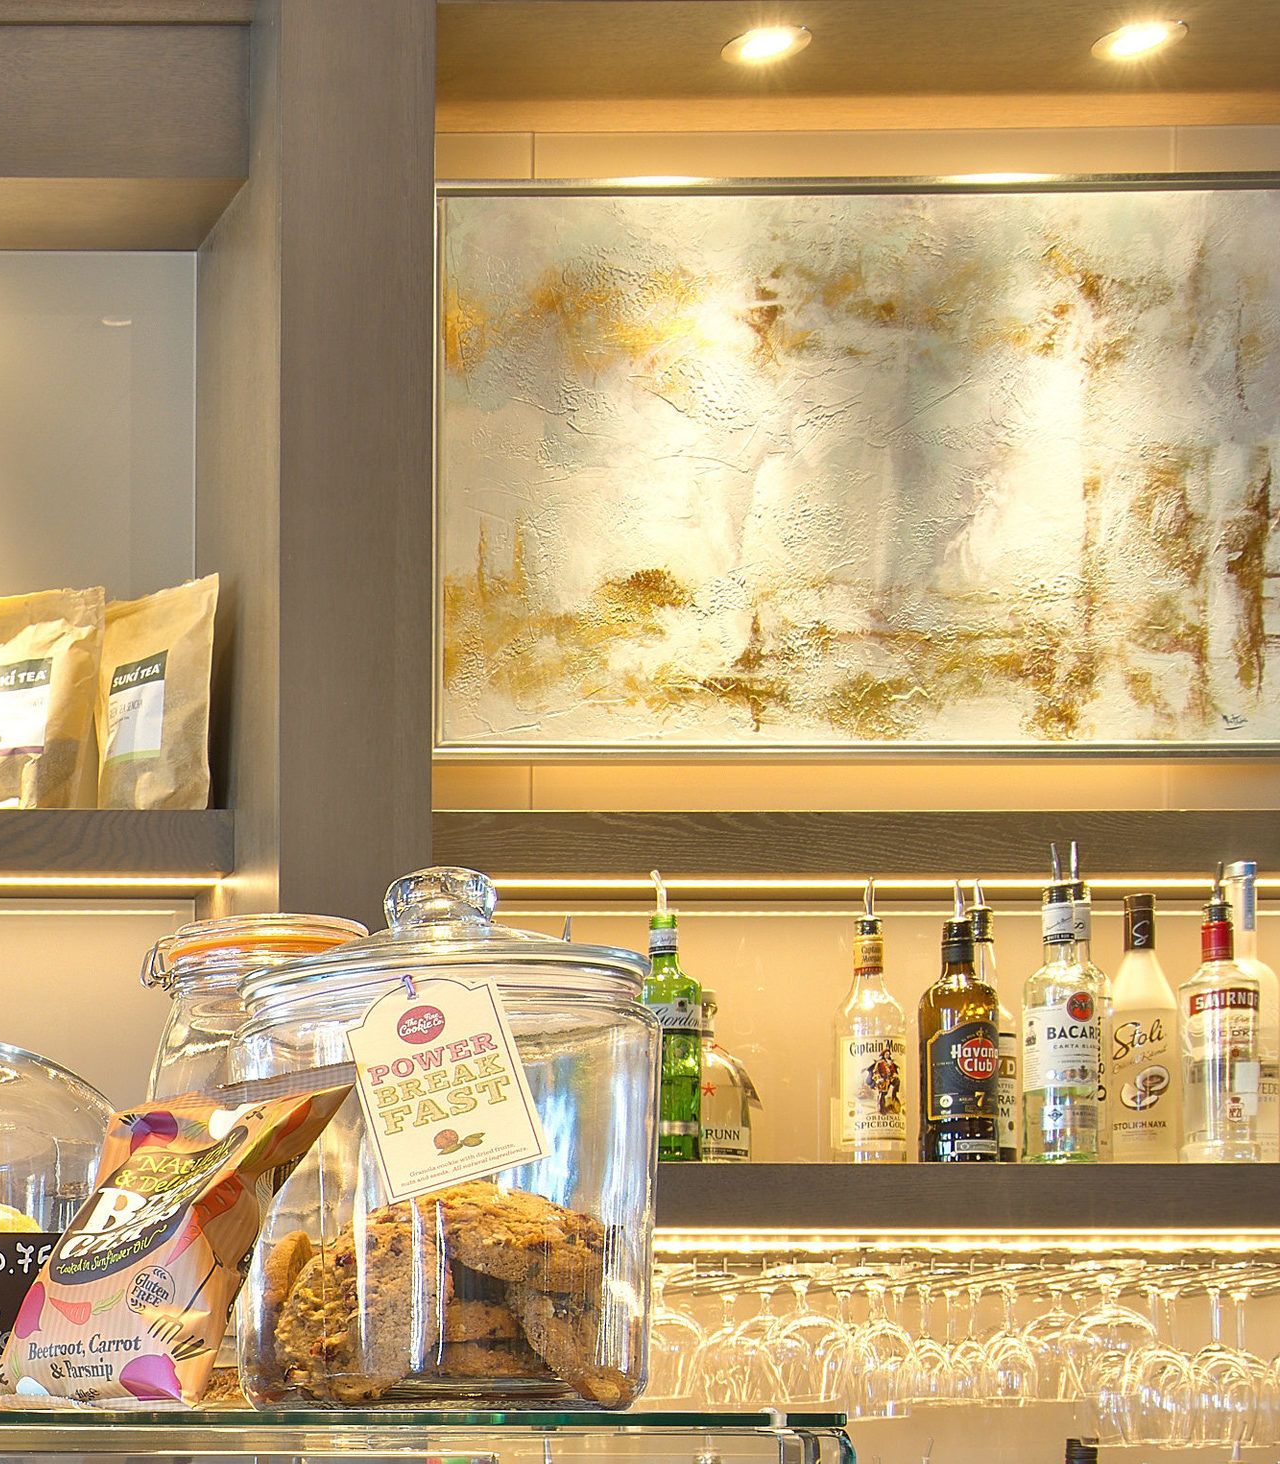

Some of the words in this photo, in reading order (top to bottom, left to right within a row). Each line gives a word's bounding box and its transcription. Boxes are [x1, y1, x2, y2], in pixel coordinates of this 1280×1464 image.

[17, 669, 49, 684] TEA
[139, 663, 163, 679] TEA
[849, 1040, 884, 1056] Captain
[1113, 1018, 1164, 1060] Stoli
[367, 1032, 497, 1086] POWER
[951, 1044, 998, 1059] Havana
[964, 1058, 993, 1072] Club
[373, 1053, 505, 1109] BREAK
[379, 1075, 510, 1136] FAST
[135, 1273, 169, 1298] Gluten
[131, 1287, 163, 1308] FREE
[28, 1340, 86, 1361] Beetroot,
[88, 1333, 142, 1353] Carrot
[50, 1363, 65, 1378] &
[65, 1358, 114, 1381] Parsnip
